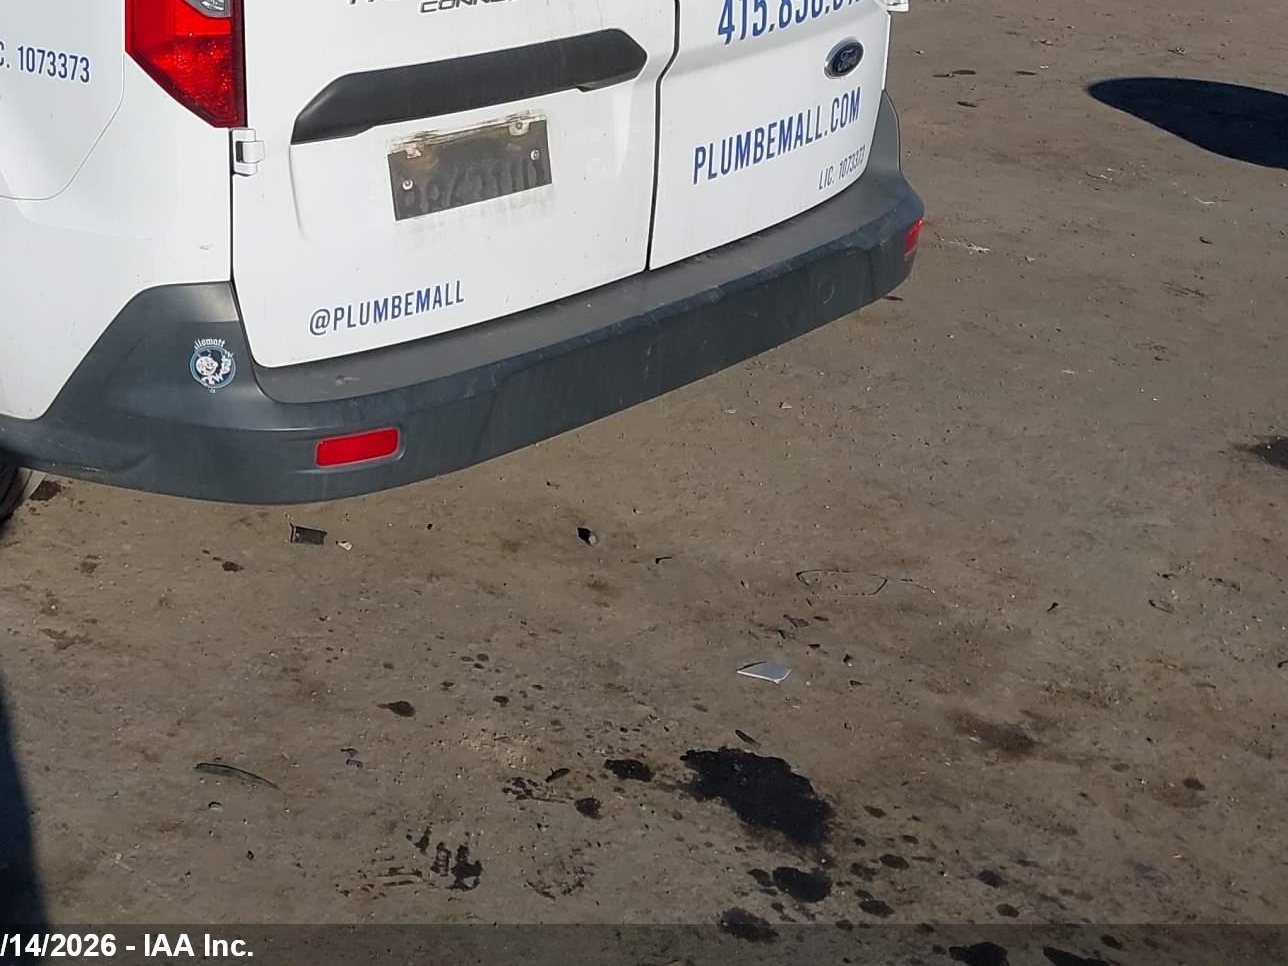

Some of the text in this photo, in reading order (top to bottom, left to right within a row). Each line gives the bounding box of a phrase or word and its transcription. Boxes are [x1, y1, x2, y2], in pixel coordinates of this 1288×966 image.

[17, 45, 90, 83] 1073373
[693, 87, 862, 185] PLUMBEMALL.COM
[819, 165, 835, 190] LIC.
[309, 281, 464, 335] @PLUMBEMALL
